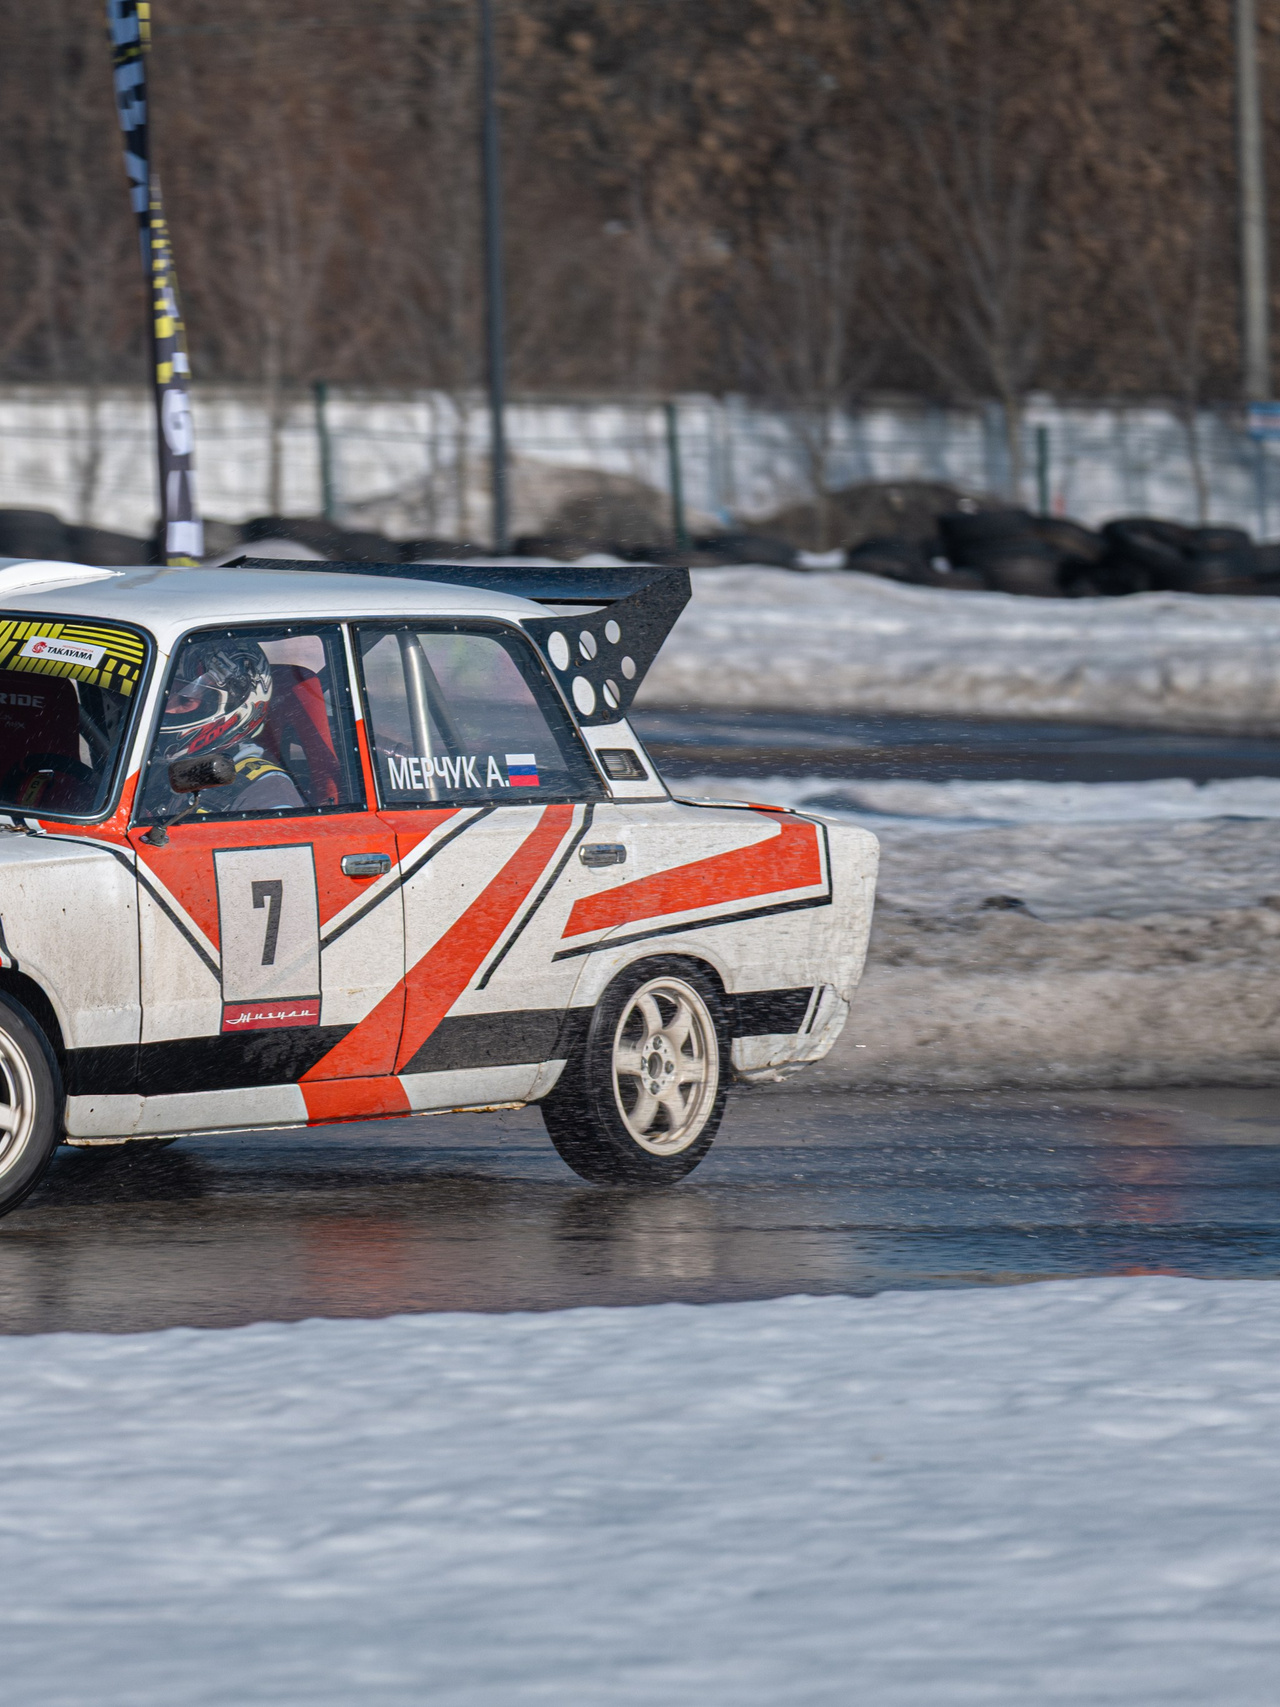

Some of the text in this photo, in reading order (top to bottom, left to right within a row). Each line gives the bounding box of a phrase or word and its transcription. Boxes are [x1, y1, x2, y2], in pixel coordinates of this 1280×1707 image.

[47, 646, 93, 661] TAKAYAMA
[387, 755, 510, 790] МЕРЧУК А.
[251, 879, 283, 966] 7
